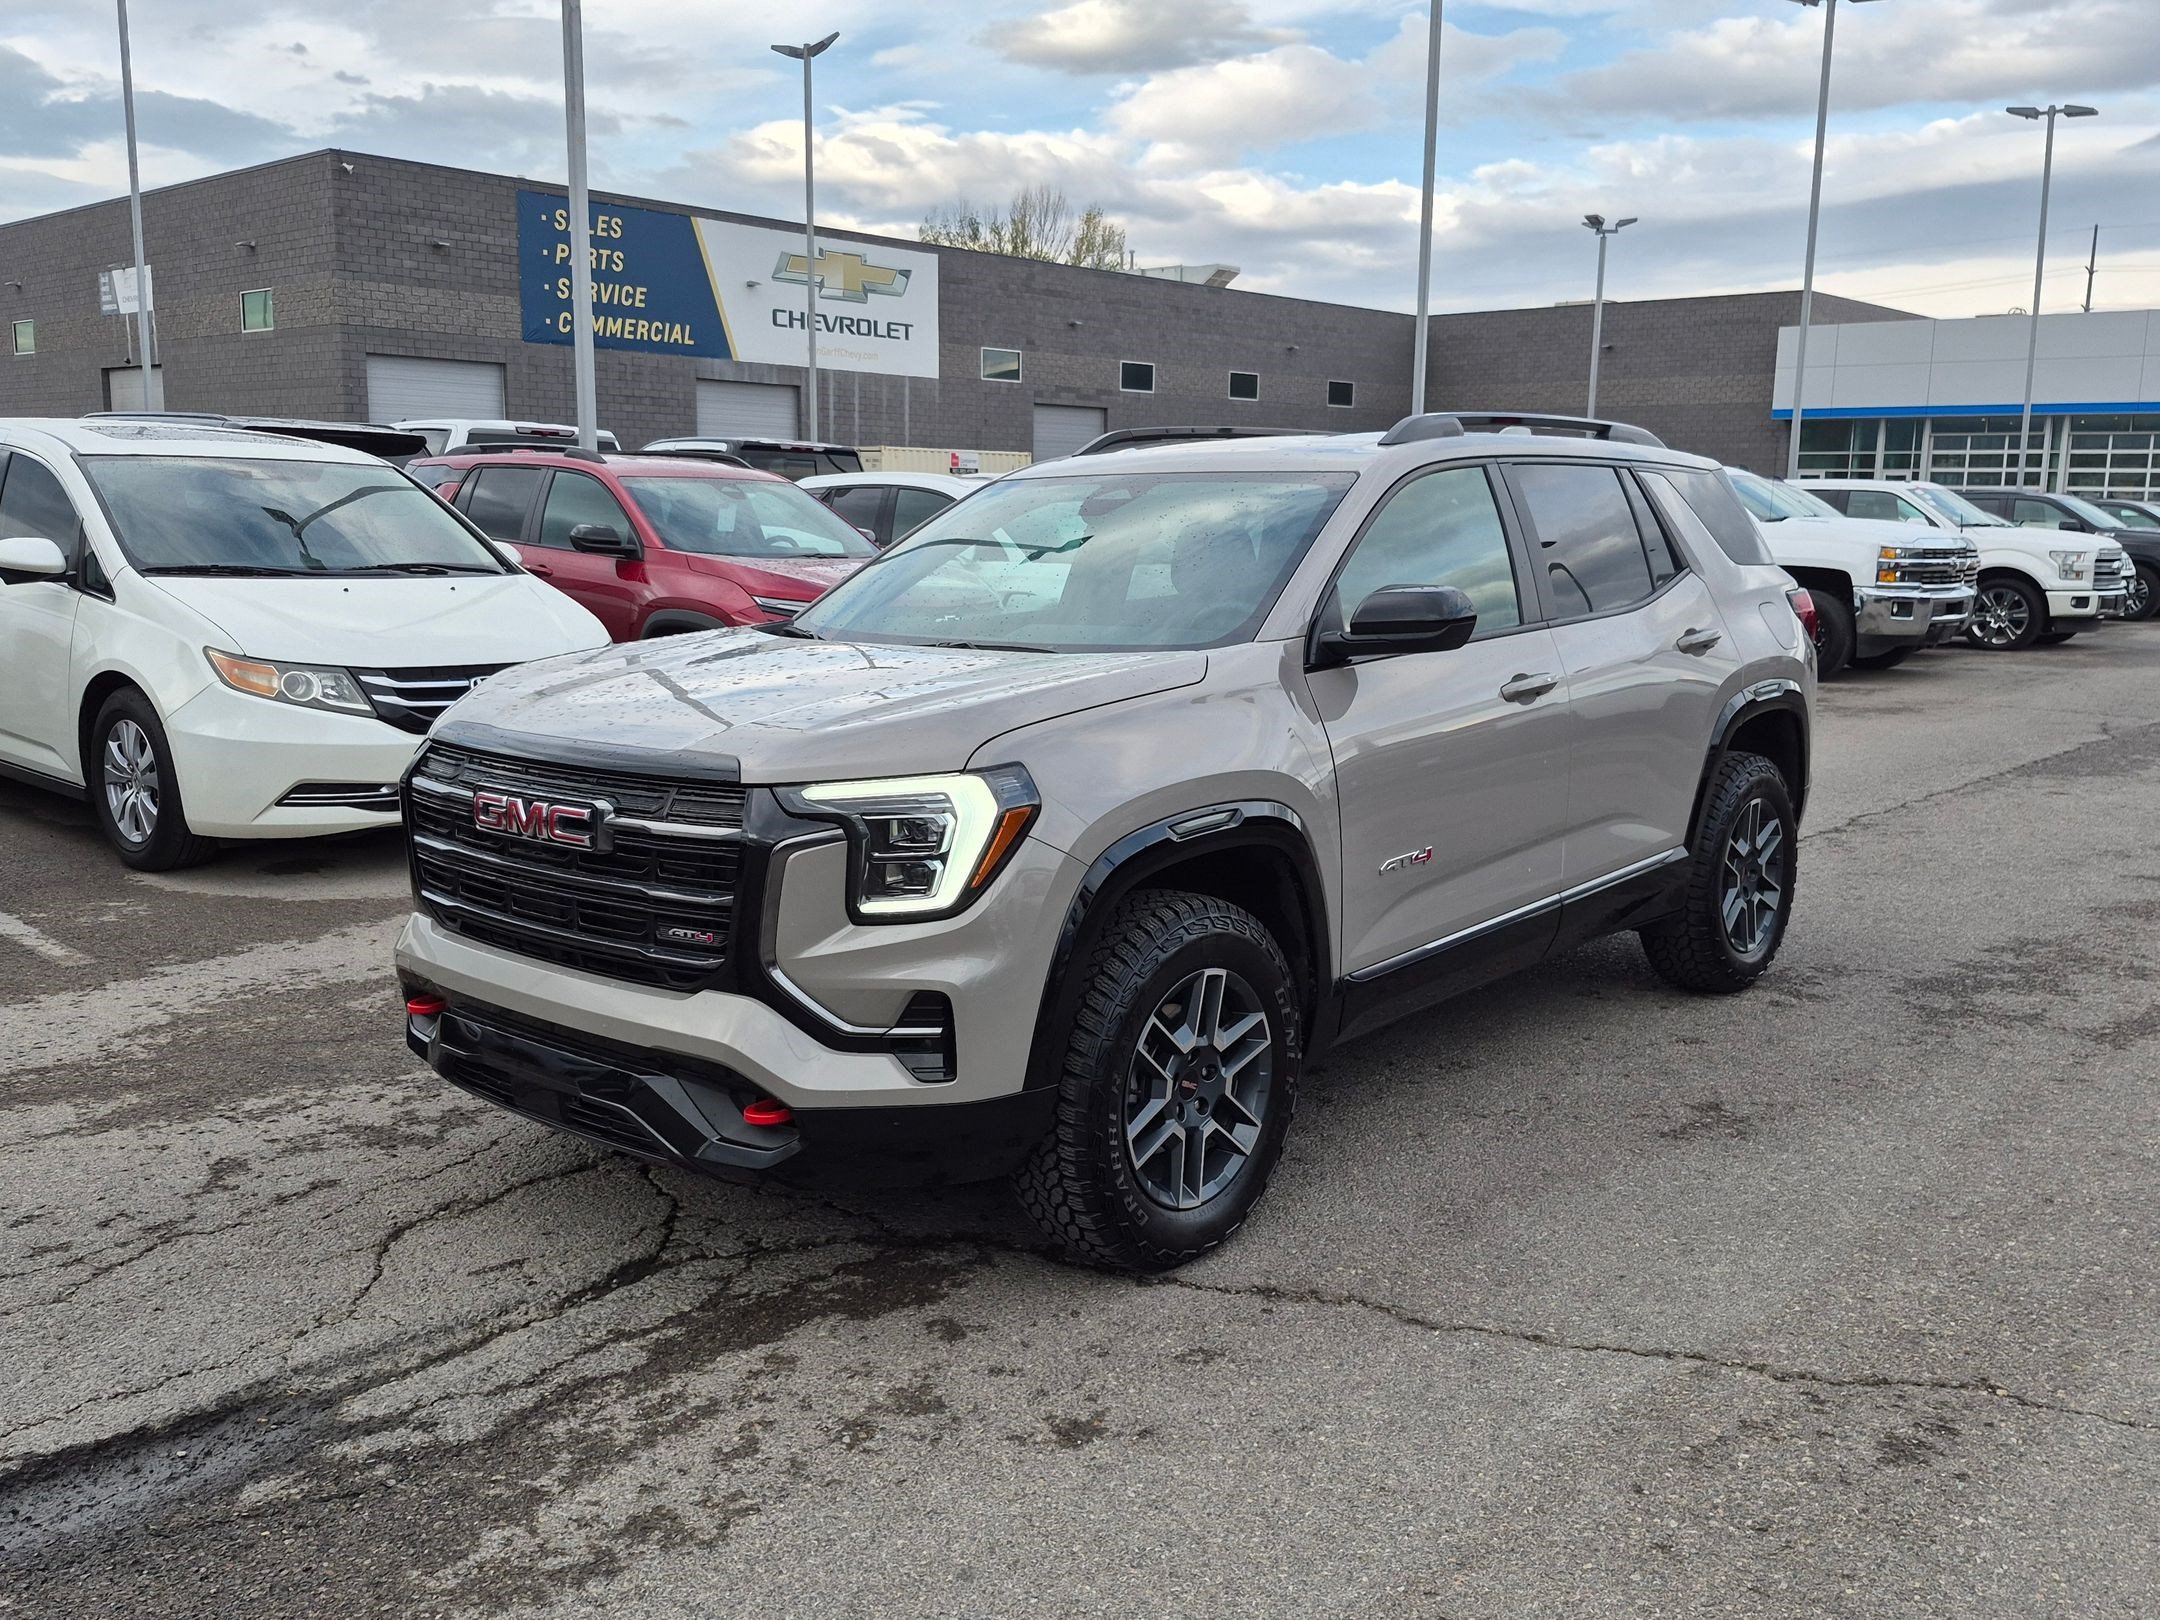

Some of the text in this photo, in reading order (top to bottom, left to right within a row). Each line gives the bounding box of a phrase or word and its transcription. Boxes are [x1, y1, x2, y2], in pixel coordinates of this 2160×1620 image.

[554, 209, 623, 239] SES
[555, 243, 625, 272] PRTS
[557, 278, 647, 308] SRVICE
[558, 312, 695, 345] CMMERCIAL
[772, 308, 914, 341] CHEVROLET
[807, 345, 879, 362] nGarffChevy.com
[474, 791, 592, 847] GMC
[1379, 846, 1433, 876] AT4
[668, 928, 714, 943] AT4
